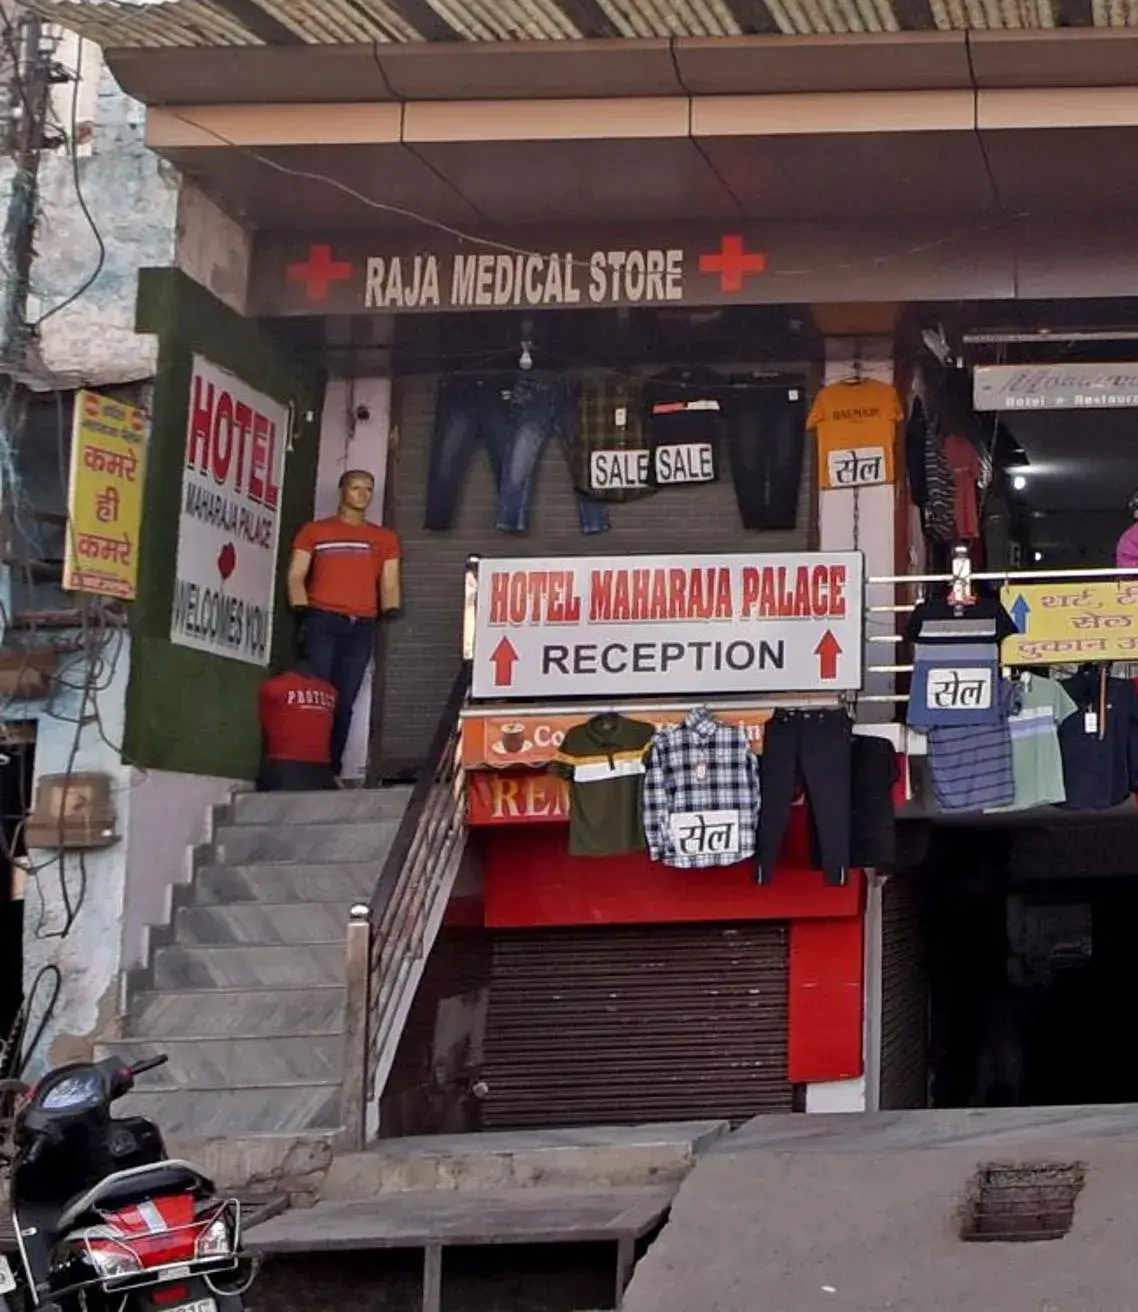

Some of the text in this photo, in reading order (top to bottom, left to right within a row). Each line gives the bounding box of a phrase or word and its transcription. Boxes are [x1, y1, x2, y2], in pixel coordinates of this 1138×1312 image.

[364, 249, 684, 308] RAJA MEDICAL STORE
[187, 376, 279, 512] HOTEL
[83, 444, 139, 482] कमरे
[596, 454, 648, 485] SALE
[660, 447, 712, 480] SALE
[833, 450, 882, 484] सेल
[95, 486, 120, 523] ही
[185, 481, 274, 549] MAHARAJA PALACE
[77, 532, 134, 566] कमरे
[488, 564, 846, 626] HOTEL MAHARAJA PALACE
[1071, 612, 1133, 630] सेल
[542, 639, 785, 675] RECEPTION
[1018, 638, 1107, 658] दुकान
[933, 671, 987, 706] सेल
[679, 814, 734, 856] सेल
